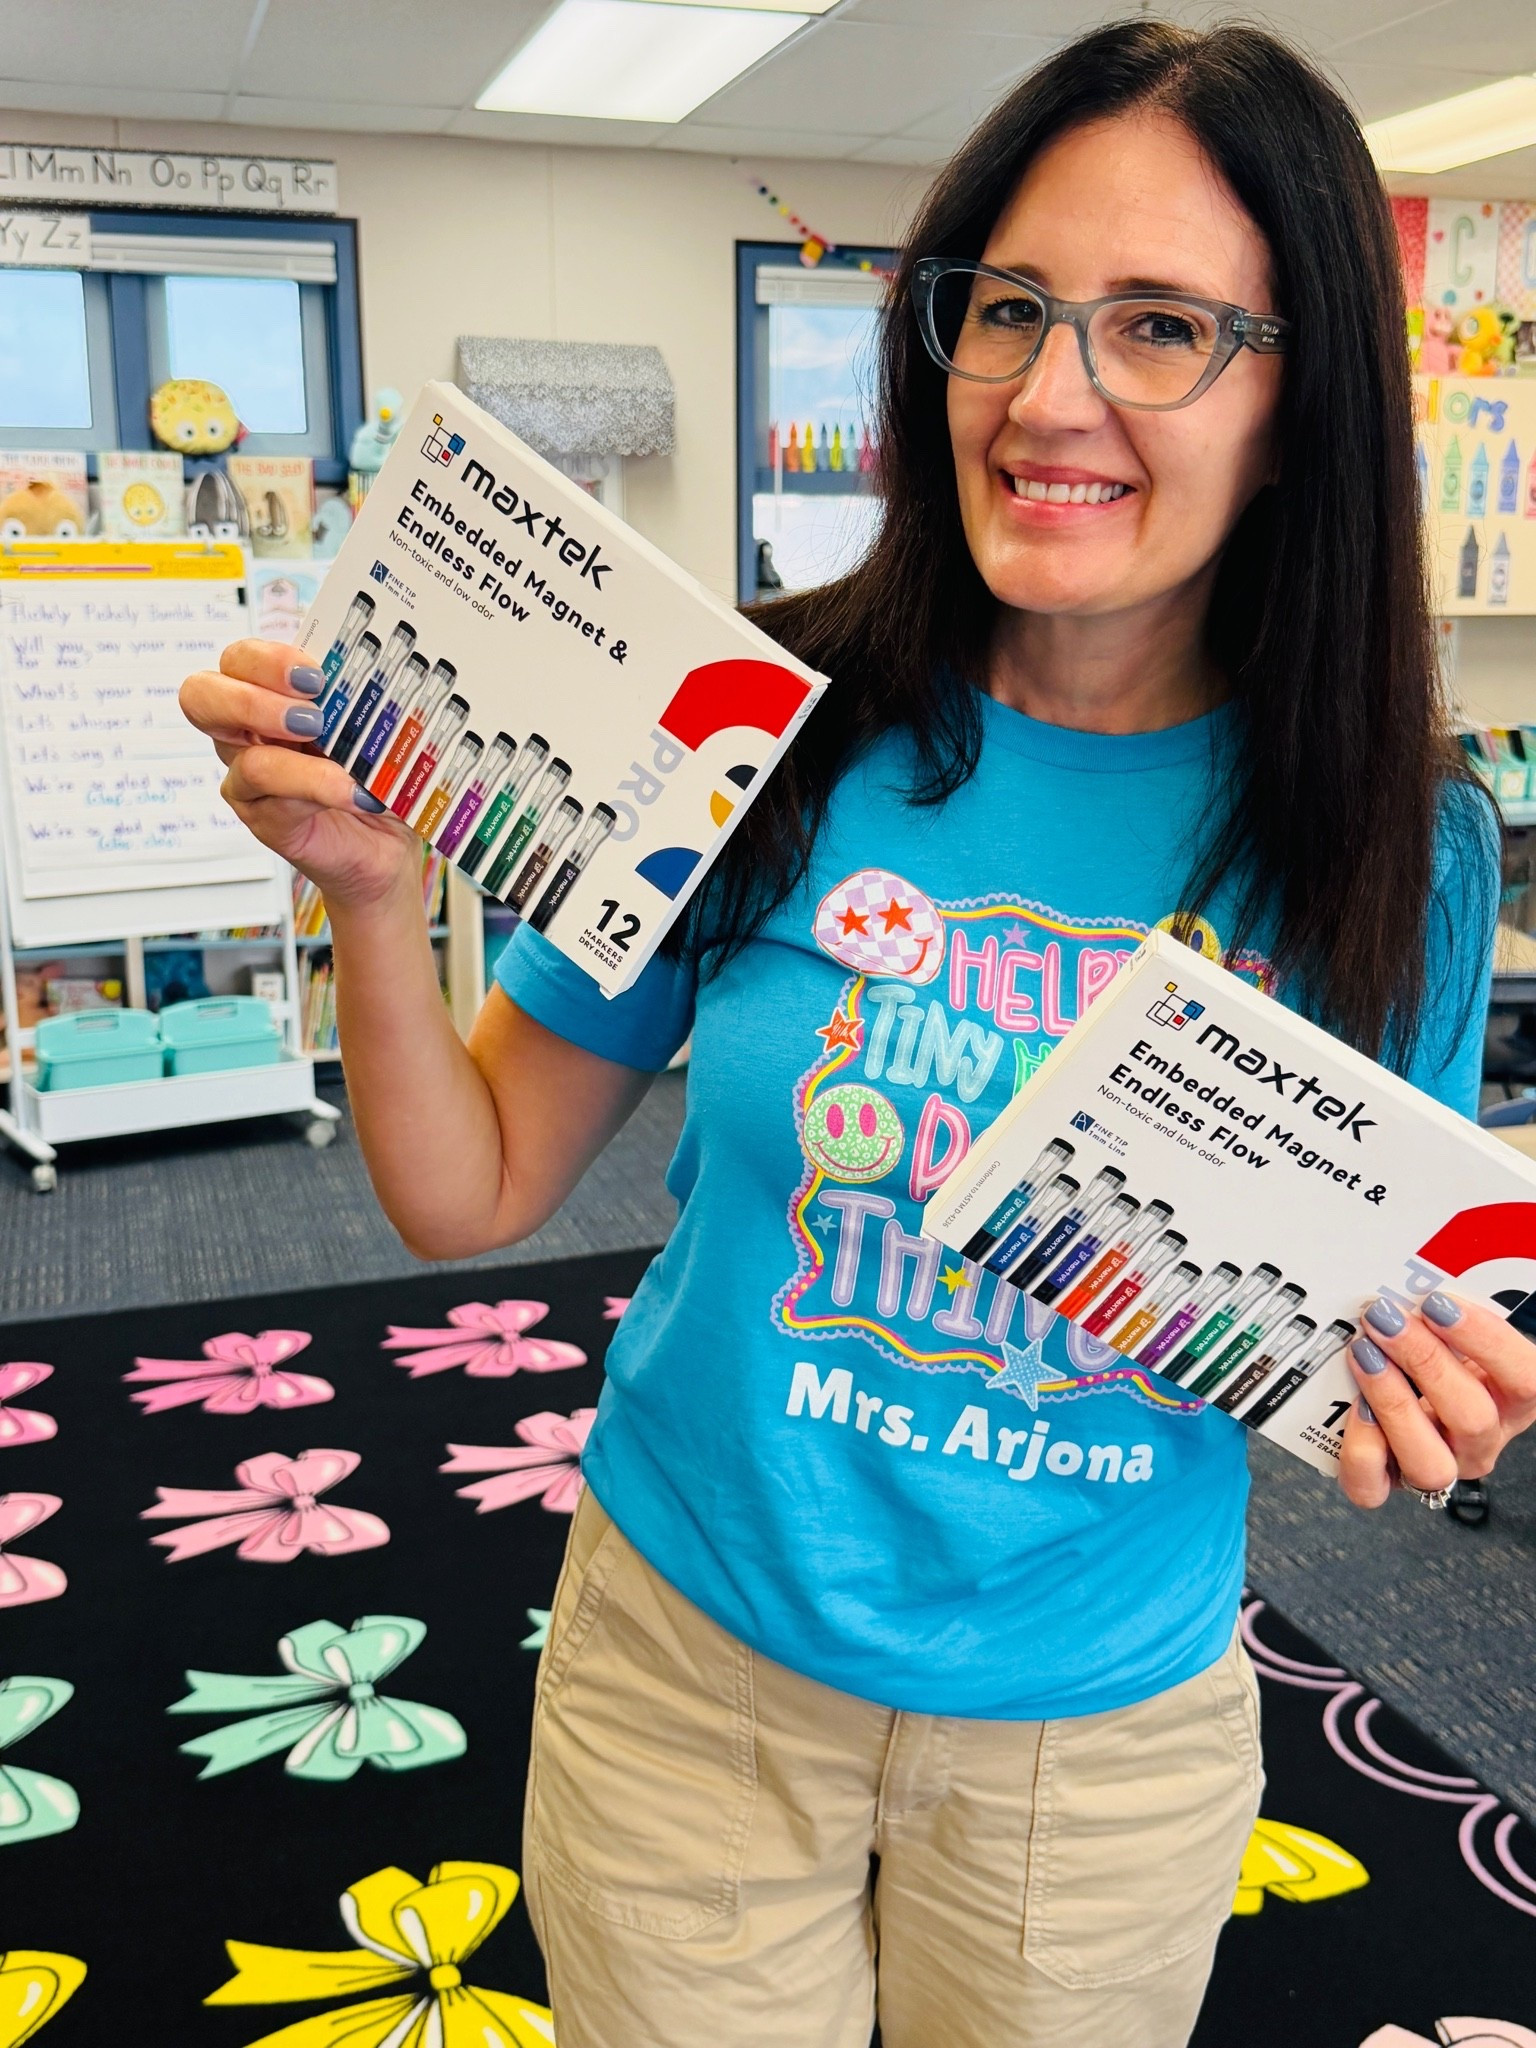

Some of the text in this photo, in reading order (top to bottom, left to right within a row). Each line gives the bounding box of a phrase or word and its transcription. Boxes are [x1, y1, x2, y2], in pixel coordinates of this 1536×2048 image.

[27, 151, 85, 184] Mm
[92, 153, 133, 187] Nn
[150, 155, 192, 189] Oo
[201, 158, 235, 203] Pp
[242, 161, 284, 208] Qq
[291, 161, 329, 196] Rr
[0, 217, 83, 260] Yy Zz
[461, 459, 614, 591] maxtek
[389, 530, 496, 621] Non-toxic and low odor
[397, 506, 531, 623] Endless Flow
[411, 479, 629, 666] Embedded Magnet &
[384, 581, 416, 610] 1mm Line
[388, 573, 417, 599] FINE TIP
[301, 618, 319, 648] Conforms
[144, 686, 179, 696] nam
[354, 699, 373, 728] maxtek
[367, 730, 386, 758] maxtek
[394, 737, 412, 765] maxtek
[406, 772, 425, 800] maxtek
[605, 728, 685, 842] PRO
[421, 808, 440, 835] maxtek
[452, 808, 472, 837] maxtek
[483, 811, 503, 838] maxtek
[505, 834, 526, 863] maxtek
[517, 872, 536, 899] maxtek
[549, 880, 569, 907] maxtek
[596, 899, 641, 953] 12
[578, 936, 619, 971] DRY ERASE
[584, 928, 623, 963] MARKERS
[950, 929, 1134, 1038] HELP
[863, 984, 1004, 1104] TINY
[1196, 1022, 1380, 1143] maxtek
[1096, 1083, 1228, 1169] Non-toxic and low odor
[1108, 1062, 1205, 1134] Endless
[1208, 1126, 1272, 1171] Flow
[1128, 1039, 1267, 1132] Embedded
[1265, 1123, 1364, 1193] Magnet
[1364, 1184, 1389, 1207] &
[1087, 1130, 1126, 1157] 1mm Line
[1093, 1122, 1129, 1148] FINE TIP
[976, 1160, 1001, 1188] Conforms
[959, 1193, 974, 1210] ASTM
[970, 1186, 980, 1194] to
[992, 1206, 1016, 1232] maxtek
[998, 1239, 1022, 1265] maxtek
[1042, 1232, 1067, 1258] maxtek
[1056, 1258, 1080, 1284] maxtek
[1088, 1265, 1114, 1291] maxtek
[1102, 1294, 1127, 1320] maxtek
[1117, 1326, 1141, 1350] maxtek
[1156, 1327, 1180, 1352] maxtek
[1194, 1327, 1219, 1353] maxtek
[1218, 1346, 1244, 1372] maxtek
[1228, 1377, 1254, 1402] maxtek
[1266, 1382, 1292, 1408] maxtek
[785, 1362, 1155, 1483] Mrs. Arjona
[1322, 1400, 1352, 1438] 1
[1299, 1431, 1340, 1460] DRY ERAS
